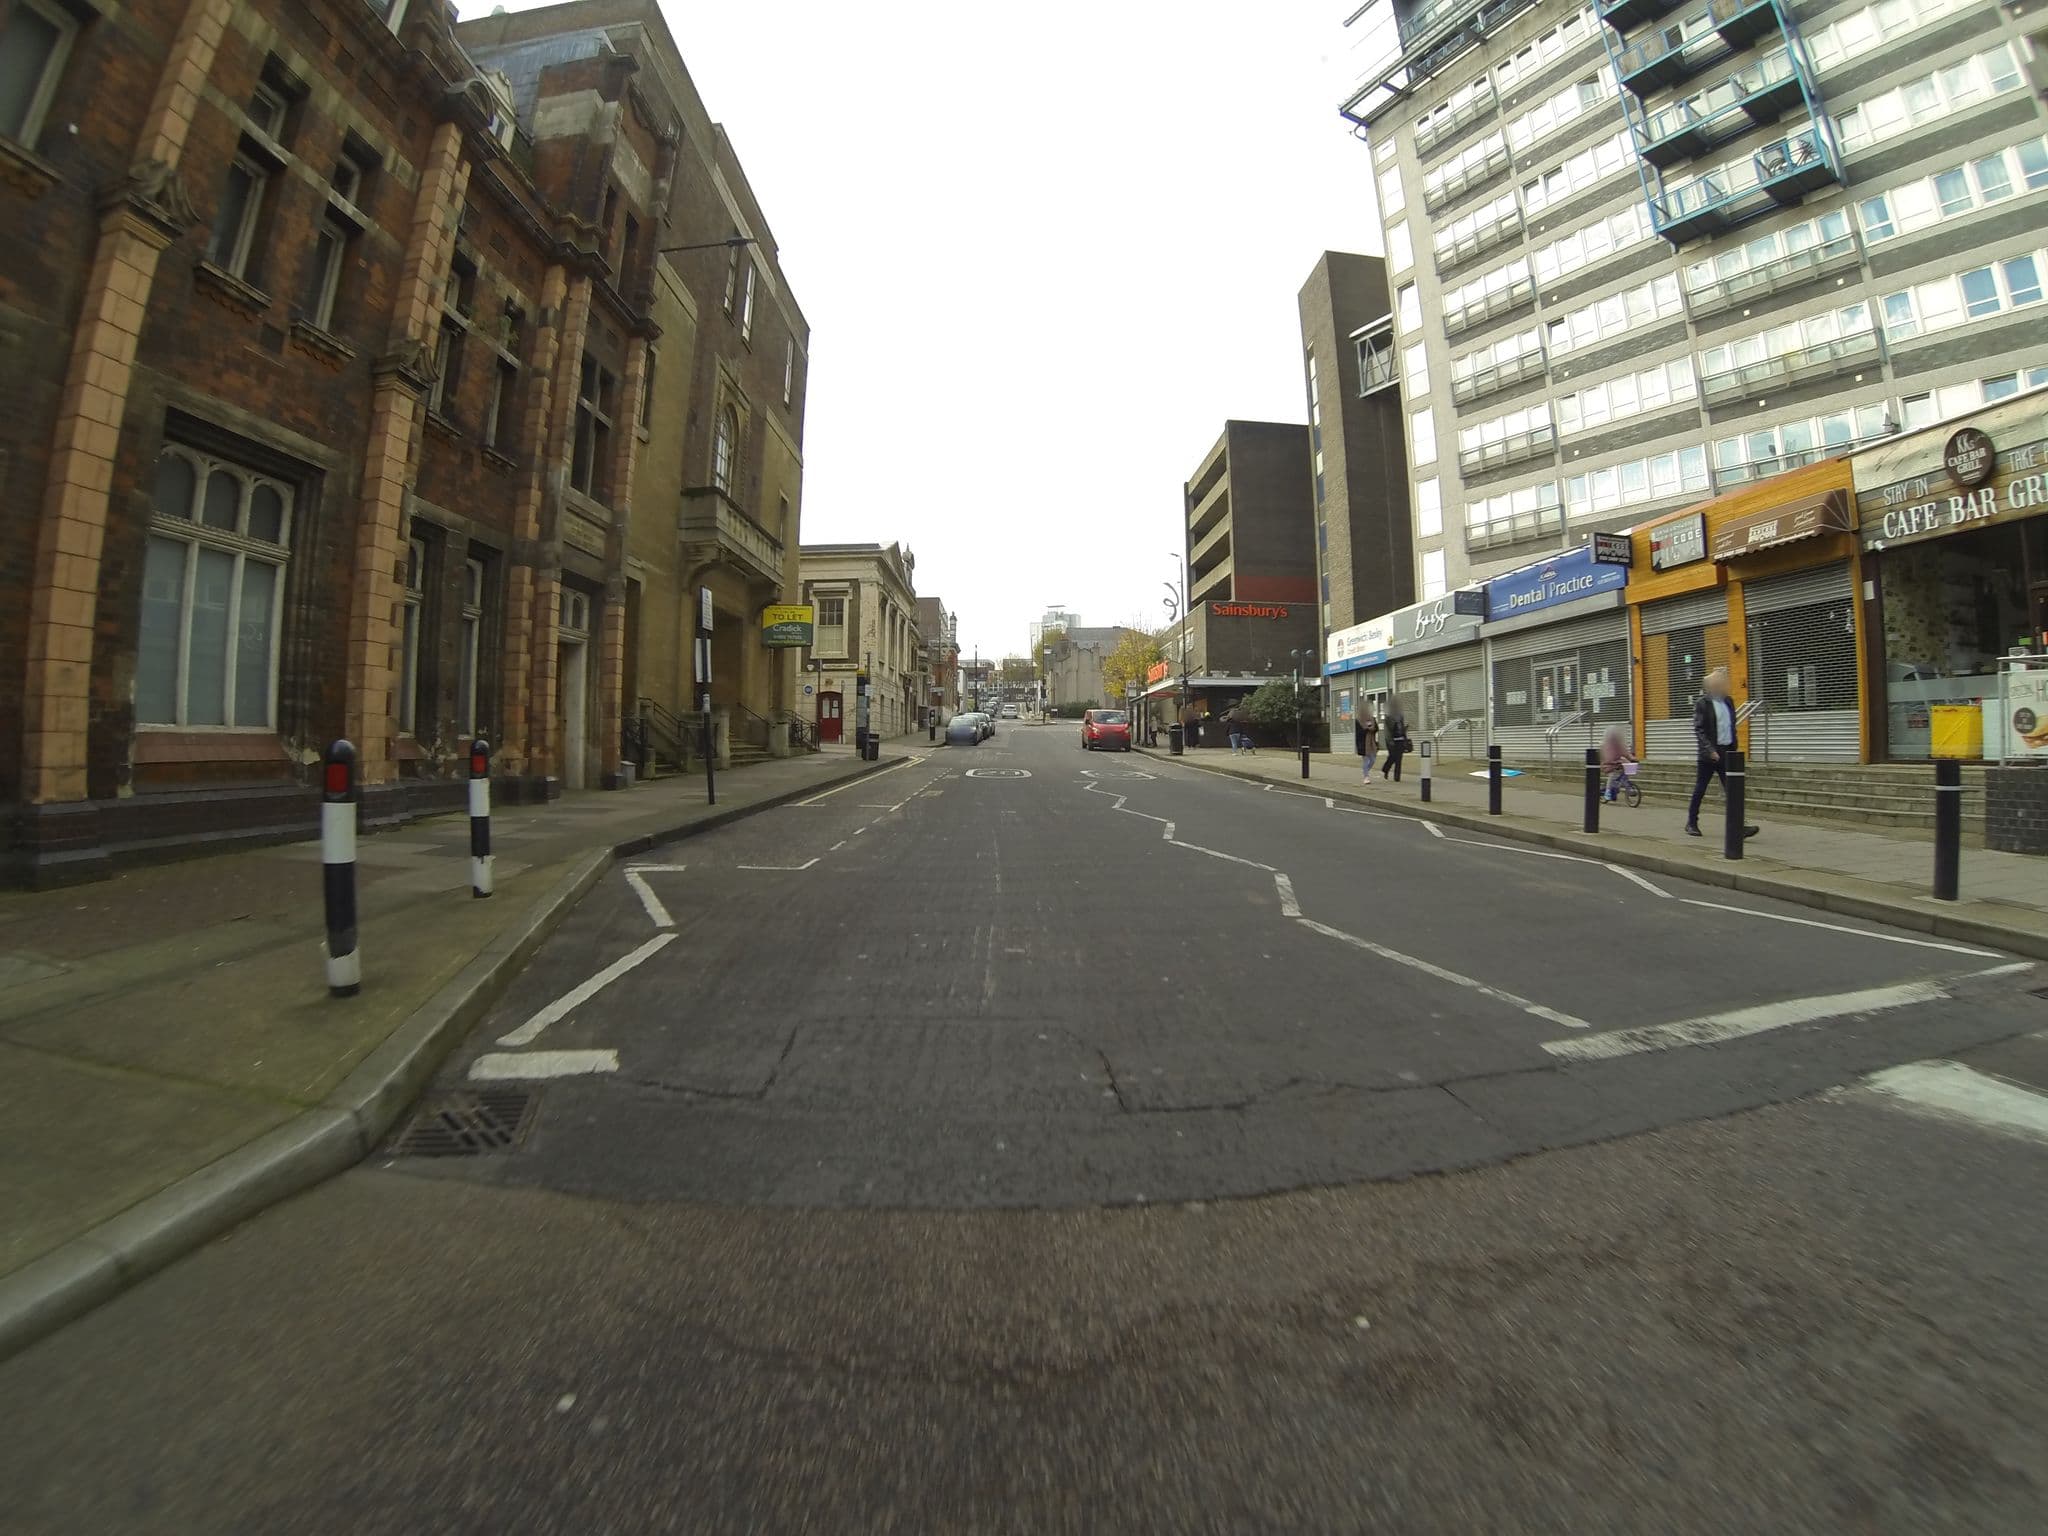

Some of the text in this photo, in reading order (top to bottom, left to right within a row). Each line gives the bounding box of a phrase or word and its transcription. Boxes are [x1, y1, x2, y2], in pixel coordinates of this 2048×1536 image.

[1948, 448, 1986, 467] CAFE BAR
[1957, 460, 1983, 474] GRILL
[2007, 445, 2037, 473] TAKE
[1883, 477, 1929, 506] STAY IN
[1883, 502, 1939, 539] CAFE
[1948, 487, 1998, 524] BAR
[1510, 585, 1546, 609] Dental
[1549, 575, 1593, 598] Practice
[772, 613, 803, 621] TO LET
[1212, 603, 1288, 620] Sainsbury's
